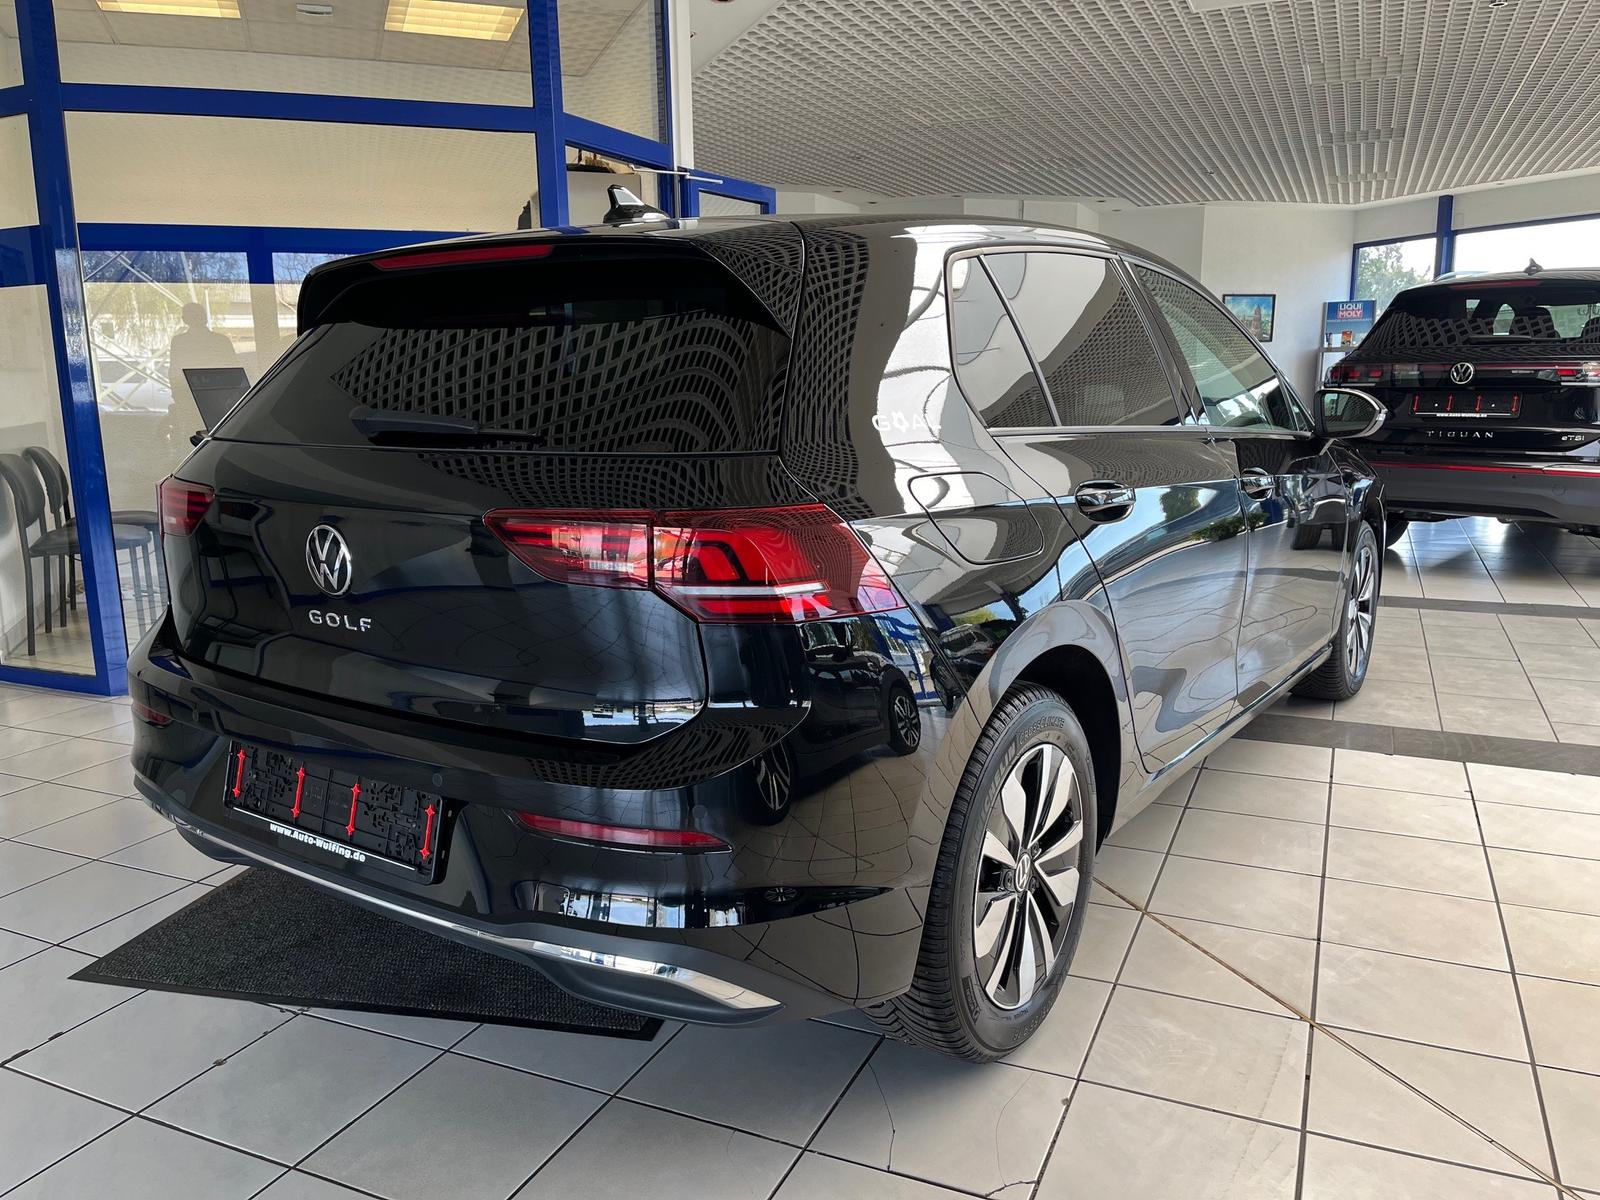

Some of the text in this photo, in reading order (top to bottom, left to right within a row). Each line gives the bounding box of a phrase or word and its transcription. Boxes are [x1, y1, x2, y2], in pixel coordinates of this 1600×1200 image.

[1340, 303, 1362, 311] LIQUI
[1339, 310, 1362, 318] MOLY
[1426, 430, 1494, 438] TIGUAN
[308, 609, 373, 632] GOLF
[269, 822, 366, 863] www.Auto-Wulfing.de
